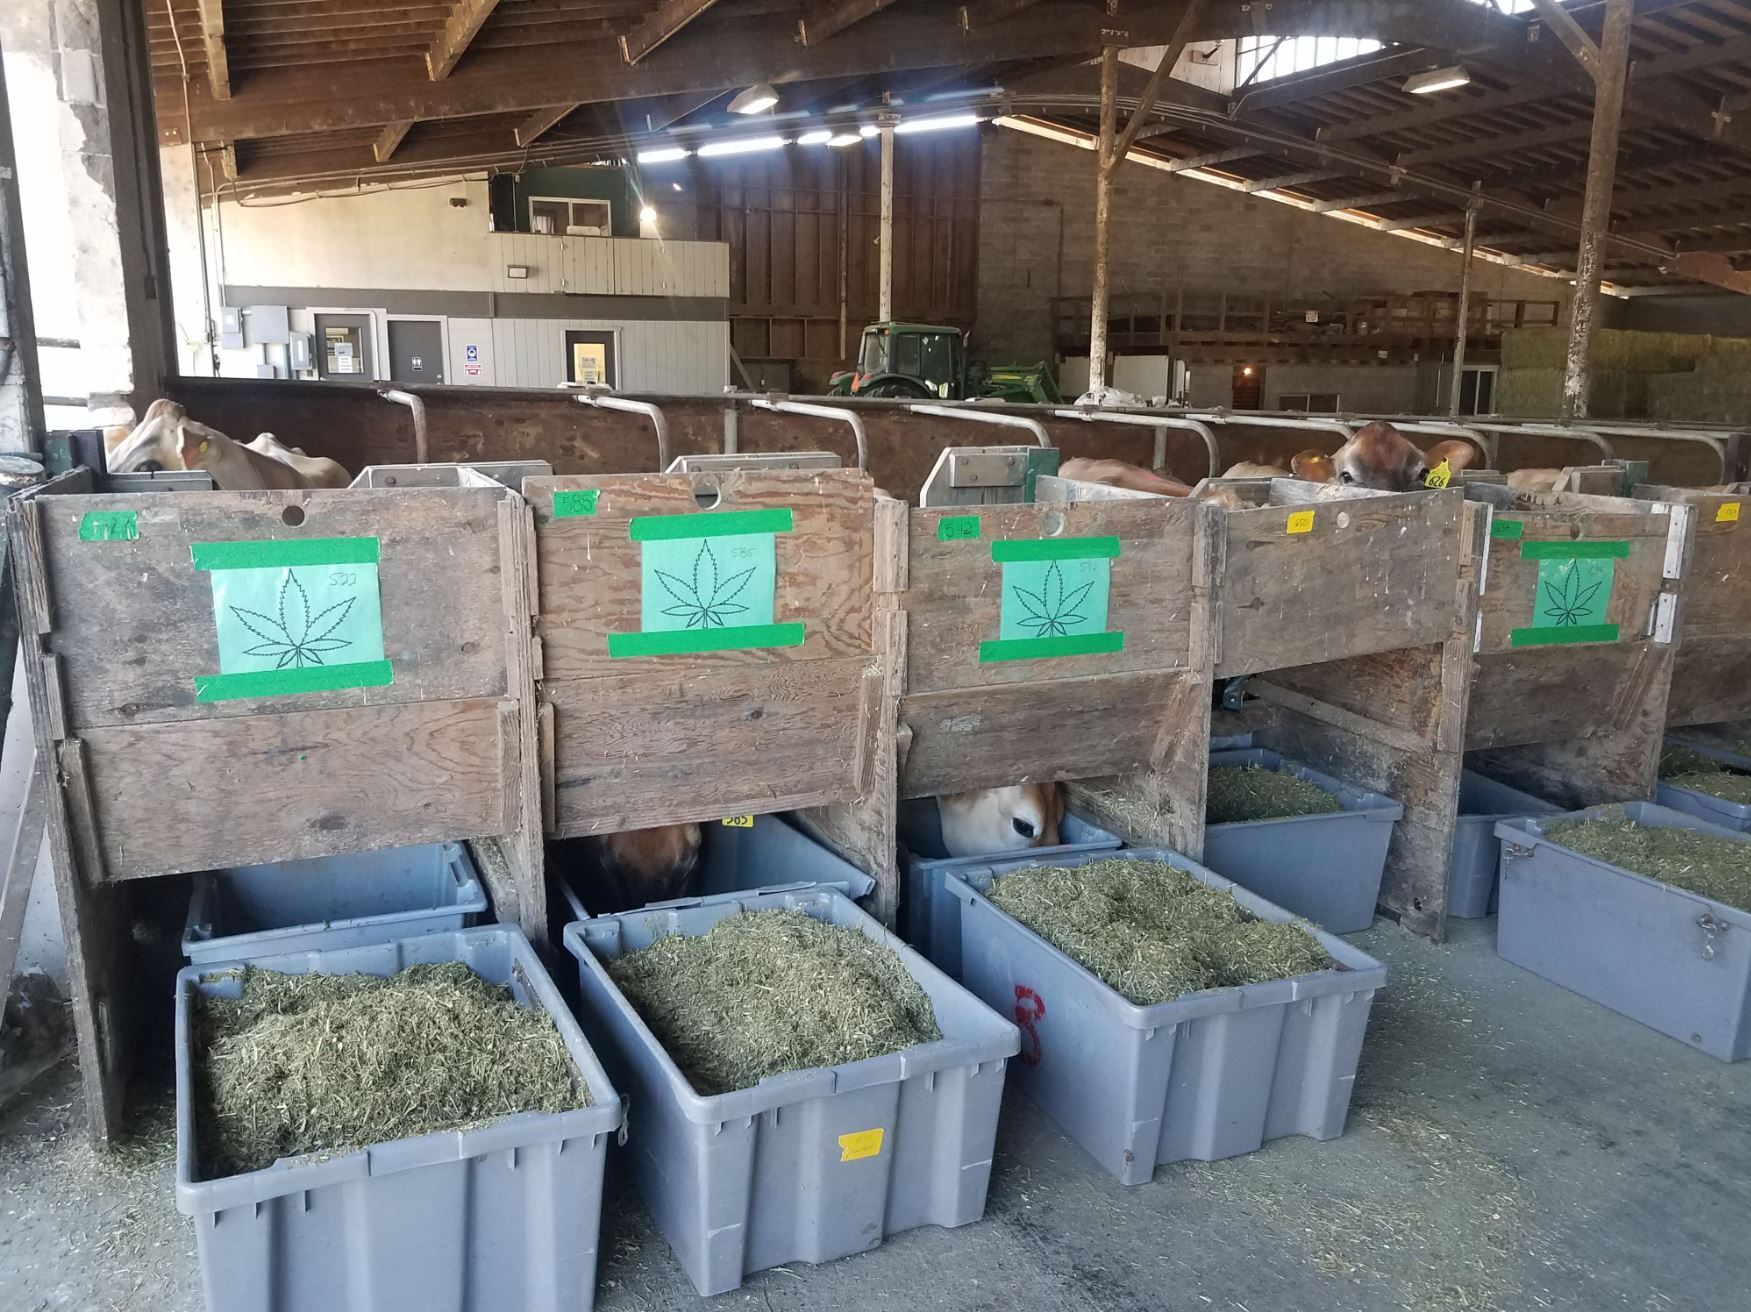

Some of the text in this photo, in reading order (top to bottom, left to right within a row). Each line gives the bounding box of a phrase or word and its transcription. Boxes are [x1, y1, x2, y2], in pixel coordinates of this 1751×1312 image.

[1429, 475, 1447, 488] 626
[944, 522, 972, 538] 542
[328, 572, 357, 588] 522
